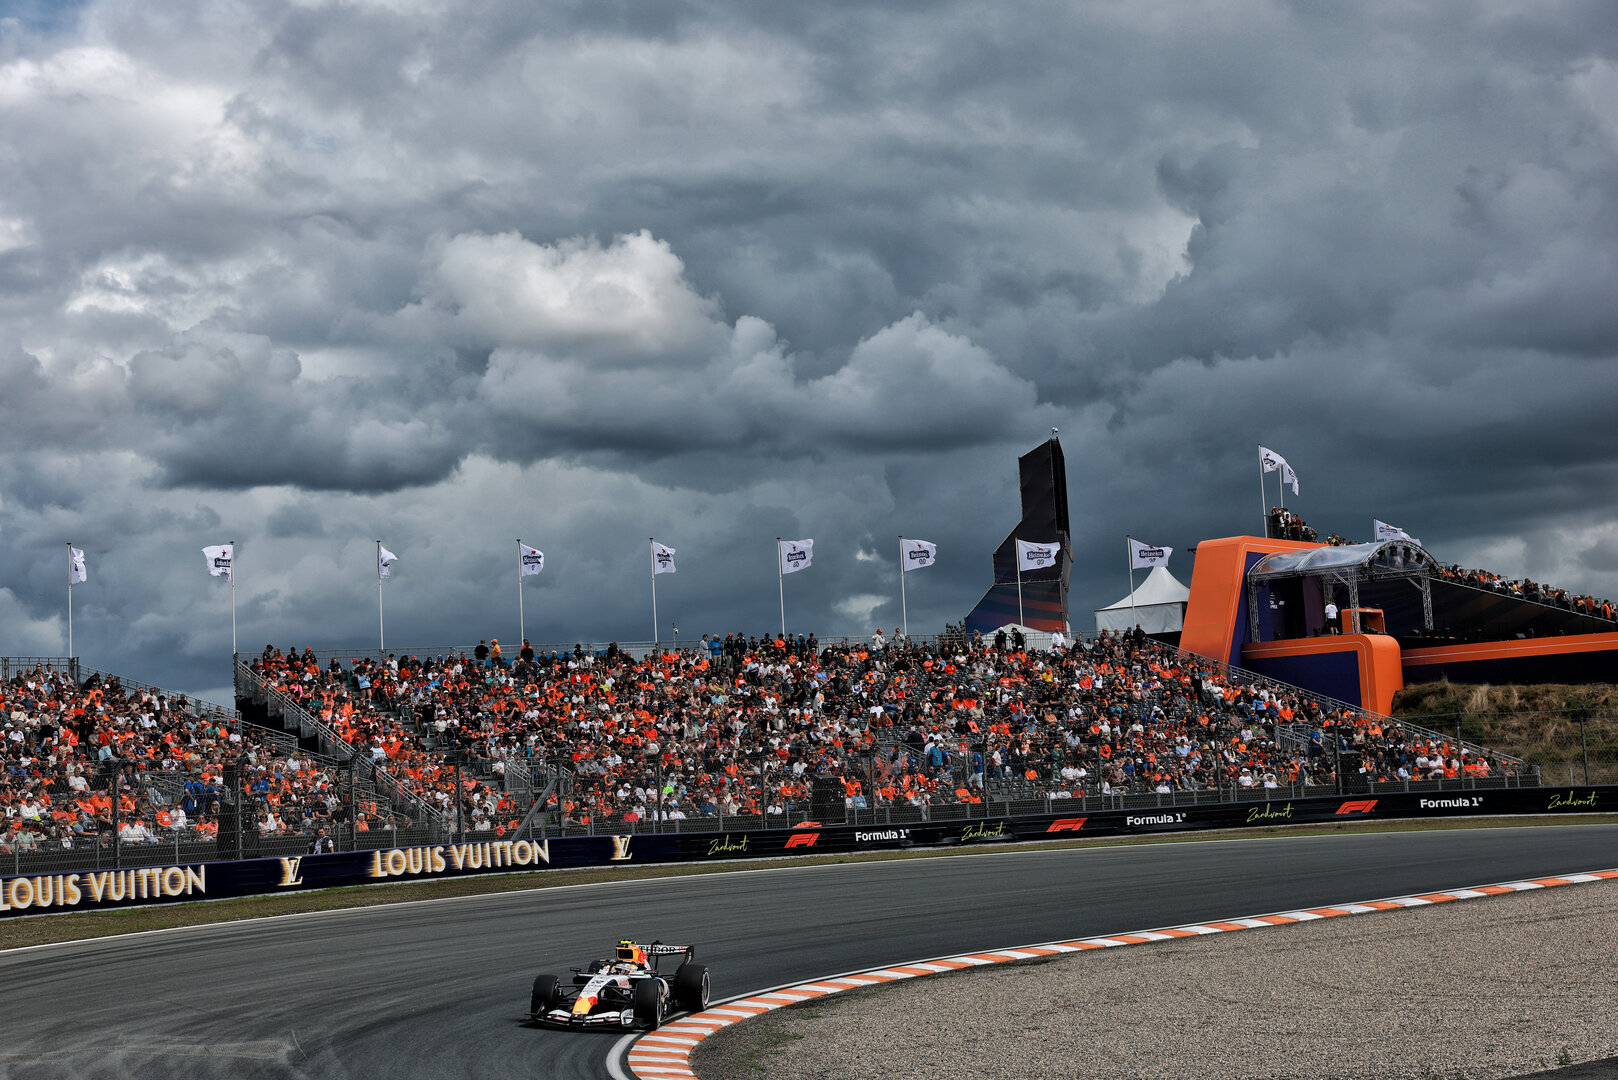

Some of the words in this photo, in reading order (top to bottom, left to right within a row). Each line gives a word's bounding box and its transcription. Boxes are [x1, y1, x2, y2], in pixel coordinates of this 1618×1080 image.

[1420, 799, 1470, 809] Formula
[1547, 791, 1599, 809] Zandvoort
[1126, 815, 1174, 826] Formula
[1246, 803, 1294, 823] Zandvoort
[855, 831, 899, 842] Formula
[960, 821, 1007, 842] Zandvoort
[707, 835, 750, 855] Zandvoort
[374, 845, 446, 877] LOUIS
[450, 838, 550, 870] VUITTON
[0, 874, 82, 911] LOUIS
[88, 864, 206, 903] VUITTON
